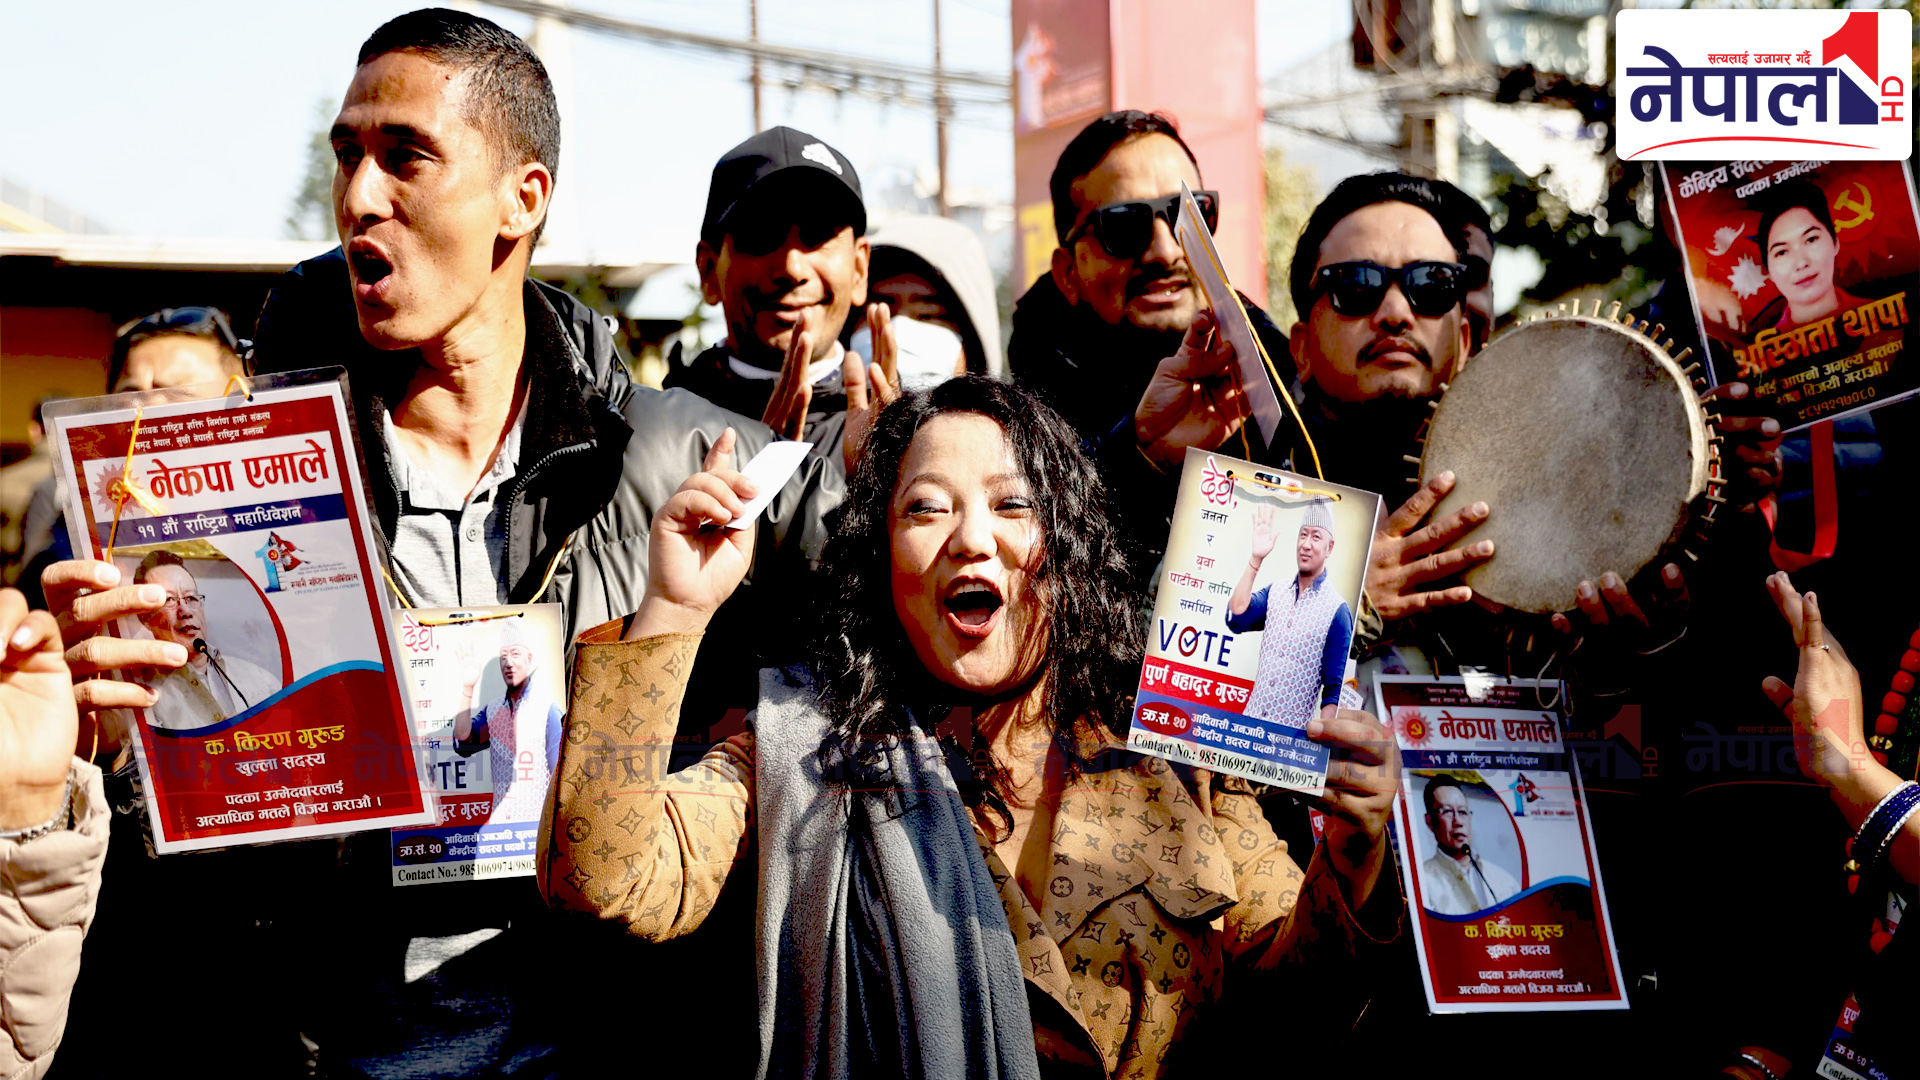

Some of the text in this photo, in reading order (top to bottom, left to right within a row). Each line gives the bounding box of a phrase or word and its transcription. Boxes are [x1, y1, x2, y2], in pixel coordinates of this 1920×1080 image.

[1735, 176, 1770, 198] पदका
[1733, 292, 1910, 379] अस्मिता थापा
[146, 438, 329, 500] नेकपा एमाले
[137, 525, 156, 538] ११
[232, 505, 302, 526] महाधिवेशन
[1201, 508, 1228, 525] जनता
[1206, 534, 1214, 548] र
[1196, 554, 1215, 570] युवा
[1170, 570, 1232, 596] पार्टीका लागि
[1180, 598, 1214, 616] समर्पित
[1160, 619, 1234, 667] VOTE
[410, 658, 434, 668] जनता
[419, 680, 426, 690] र
[1144, 664, 1170, 686] पुर्ण
[1170, 670, 1214, 698] बहादुर
[1172, 716, 1187, 730] २०
[1191, 713, 1230, 731] आदिवासी
[1230, 722, 1265, 740] जनजाति
[1267, 732, 1292, 746] खुल्ला
[1438, 710, 1558, 744] नेकपा एमाले
[204, 739, 230, 756] क.
[234, 730, 292, 753] किरण
[1192, 726, 1317, 766] केन्द्रीय सदस्य पदको उम्मेदवार
[235, 752, 326, 776] खुल्ला सदस्य
[1134, 733, 1172, 754] Contact
[1176, 745, 1196, 761] No.:
[1198, 749, 1319, 790] 9851069974/9802069974
[225, 780, 344, 806] पदका उम्मेदवारलाई
[196, 809, 255, 828] अत्याधिक
[258, 804, 290, 820] मतले
[294, 800, 329, 816] विजय
[445, 832, 480, 844] आदिवासी
[478, 844, 502, 854] सदस्य
[398, 859, 536, 882] Contact No.: 9851069974/9802
[1464, 924, 1482, 938] क.
[1485, 920, 1526, 938] किरण
[1520, 944, 1550, 956] सदस्य
[1478, 970, 1504, 980] पदका
[1458, 984, 1500, 994] अत्याधिक
